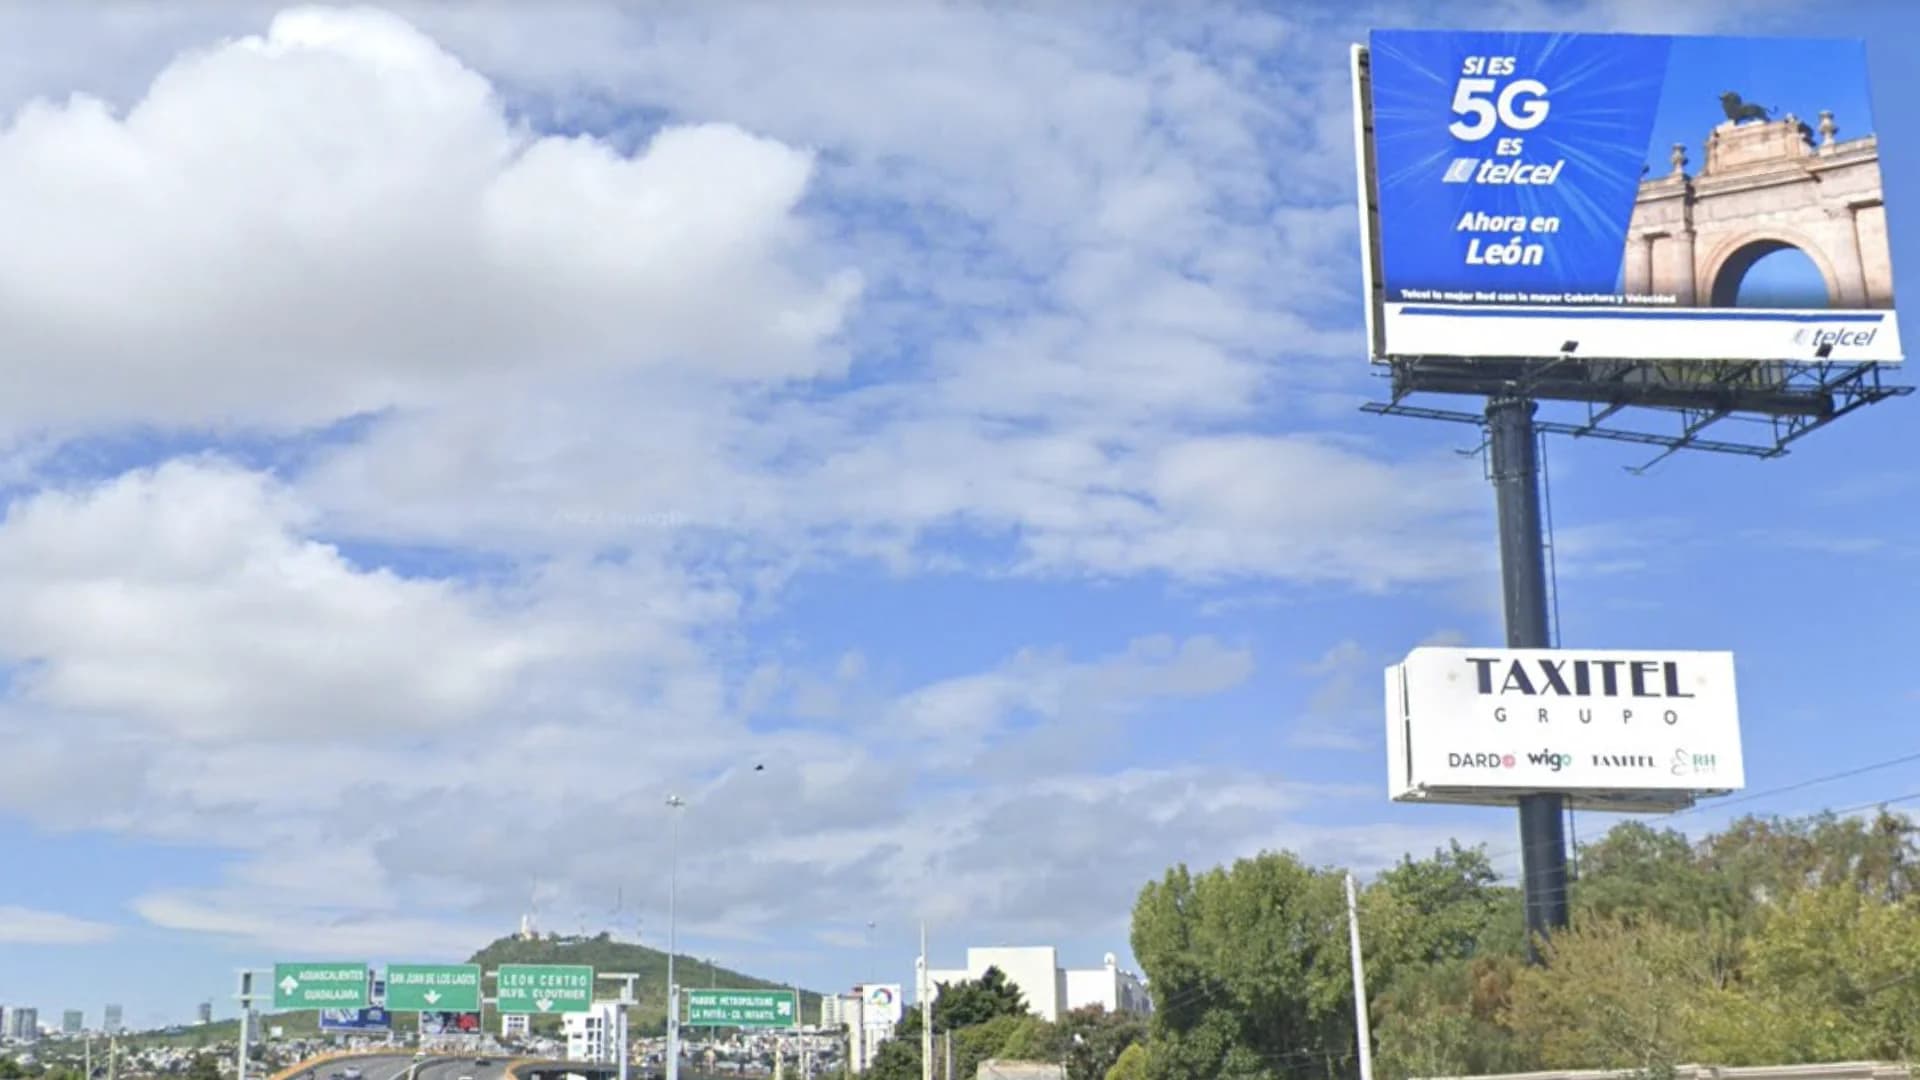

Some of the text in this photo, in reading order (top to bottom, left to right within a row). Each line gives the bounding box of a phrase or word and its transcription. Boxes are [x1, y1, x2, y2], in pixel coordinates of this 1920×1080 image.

[1462, 56, 1516, 75] SI ES
[1448, 78, 1550, 141] 5G
[1496, 137, 1524, 155] ES
[1475, 159, 1565, 185] telcel
[1457, 211, 1560, 232] Ahora en
[1465, 236, 1544, 265] León
[1400, 288, 1431, 299] Telcel
[1443, 291, 1474, 302] mejor
[1497, 293, 1517, 301] con
[1530, 294, 1562, 304] mayor
[1564, 292, 1615, 303] Cobertura
[1626, 293, 1676, 304] Velocidad
[1812, 328, 1877, 346] telcel
[1466, 658, 1695, 698] TAXITEL
[1494, 708, 1679, 726] GRUPO
[1448, 752, 1516, 769] DARDO
[1528, 748, 1572, 772] wigo
[1591, 754, 1656, 768] TAXITEL
[298, 969, 364, 981] AGUASCALIENTES
[390, 972, 476, 984] SAN JUAN DE LOS LAGOS
[503, 974, 587, 987] LEON CENTRO
[304, 989, 359, 1000] GUADALAJARA
[532, 988, 586, 1000] CLOUTHIER
[720, 996, 774, 1006] METROPOLITANO
